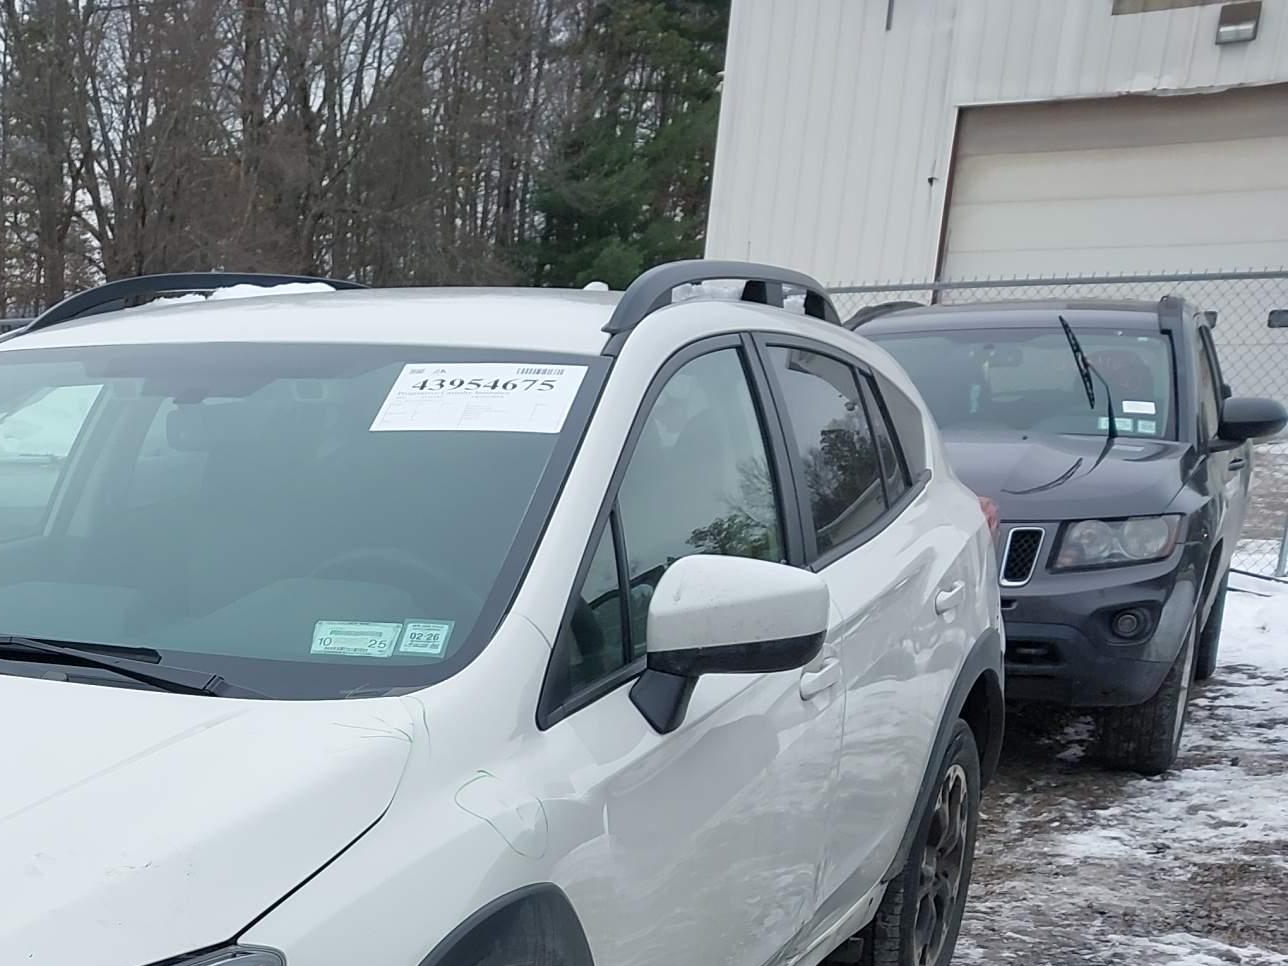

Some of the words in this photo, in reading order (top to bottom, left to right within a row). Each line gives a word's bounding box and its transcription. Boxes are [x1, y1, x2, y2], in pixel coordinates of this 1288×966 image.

[412, 378, 557, 392] 43954675
[318, 637, 332, 647] 10
[368, 639, 387, 649] 25
